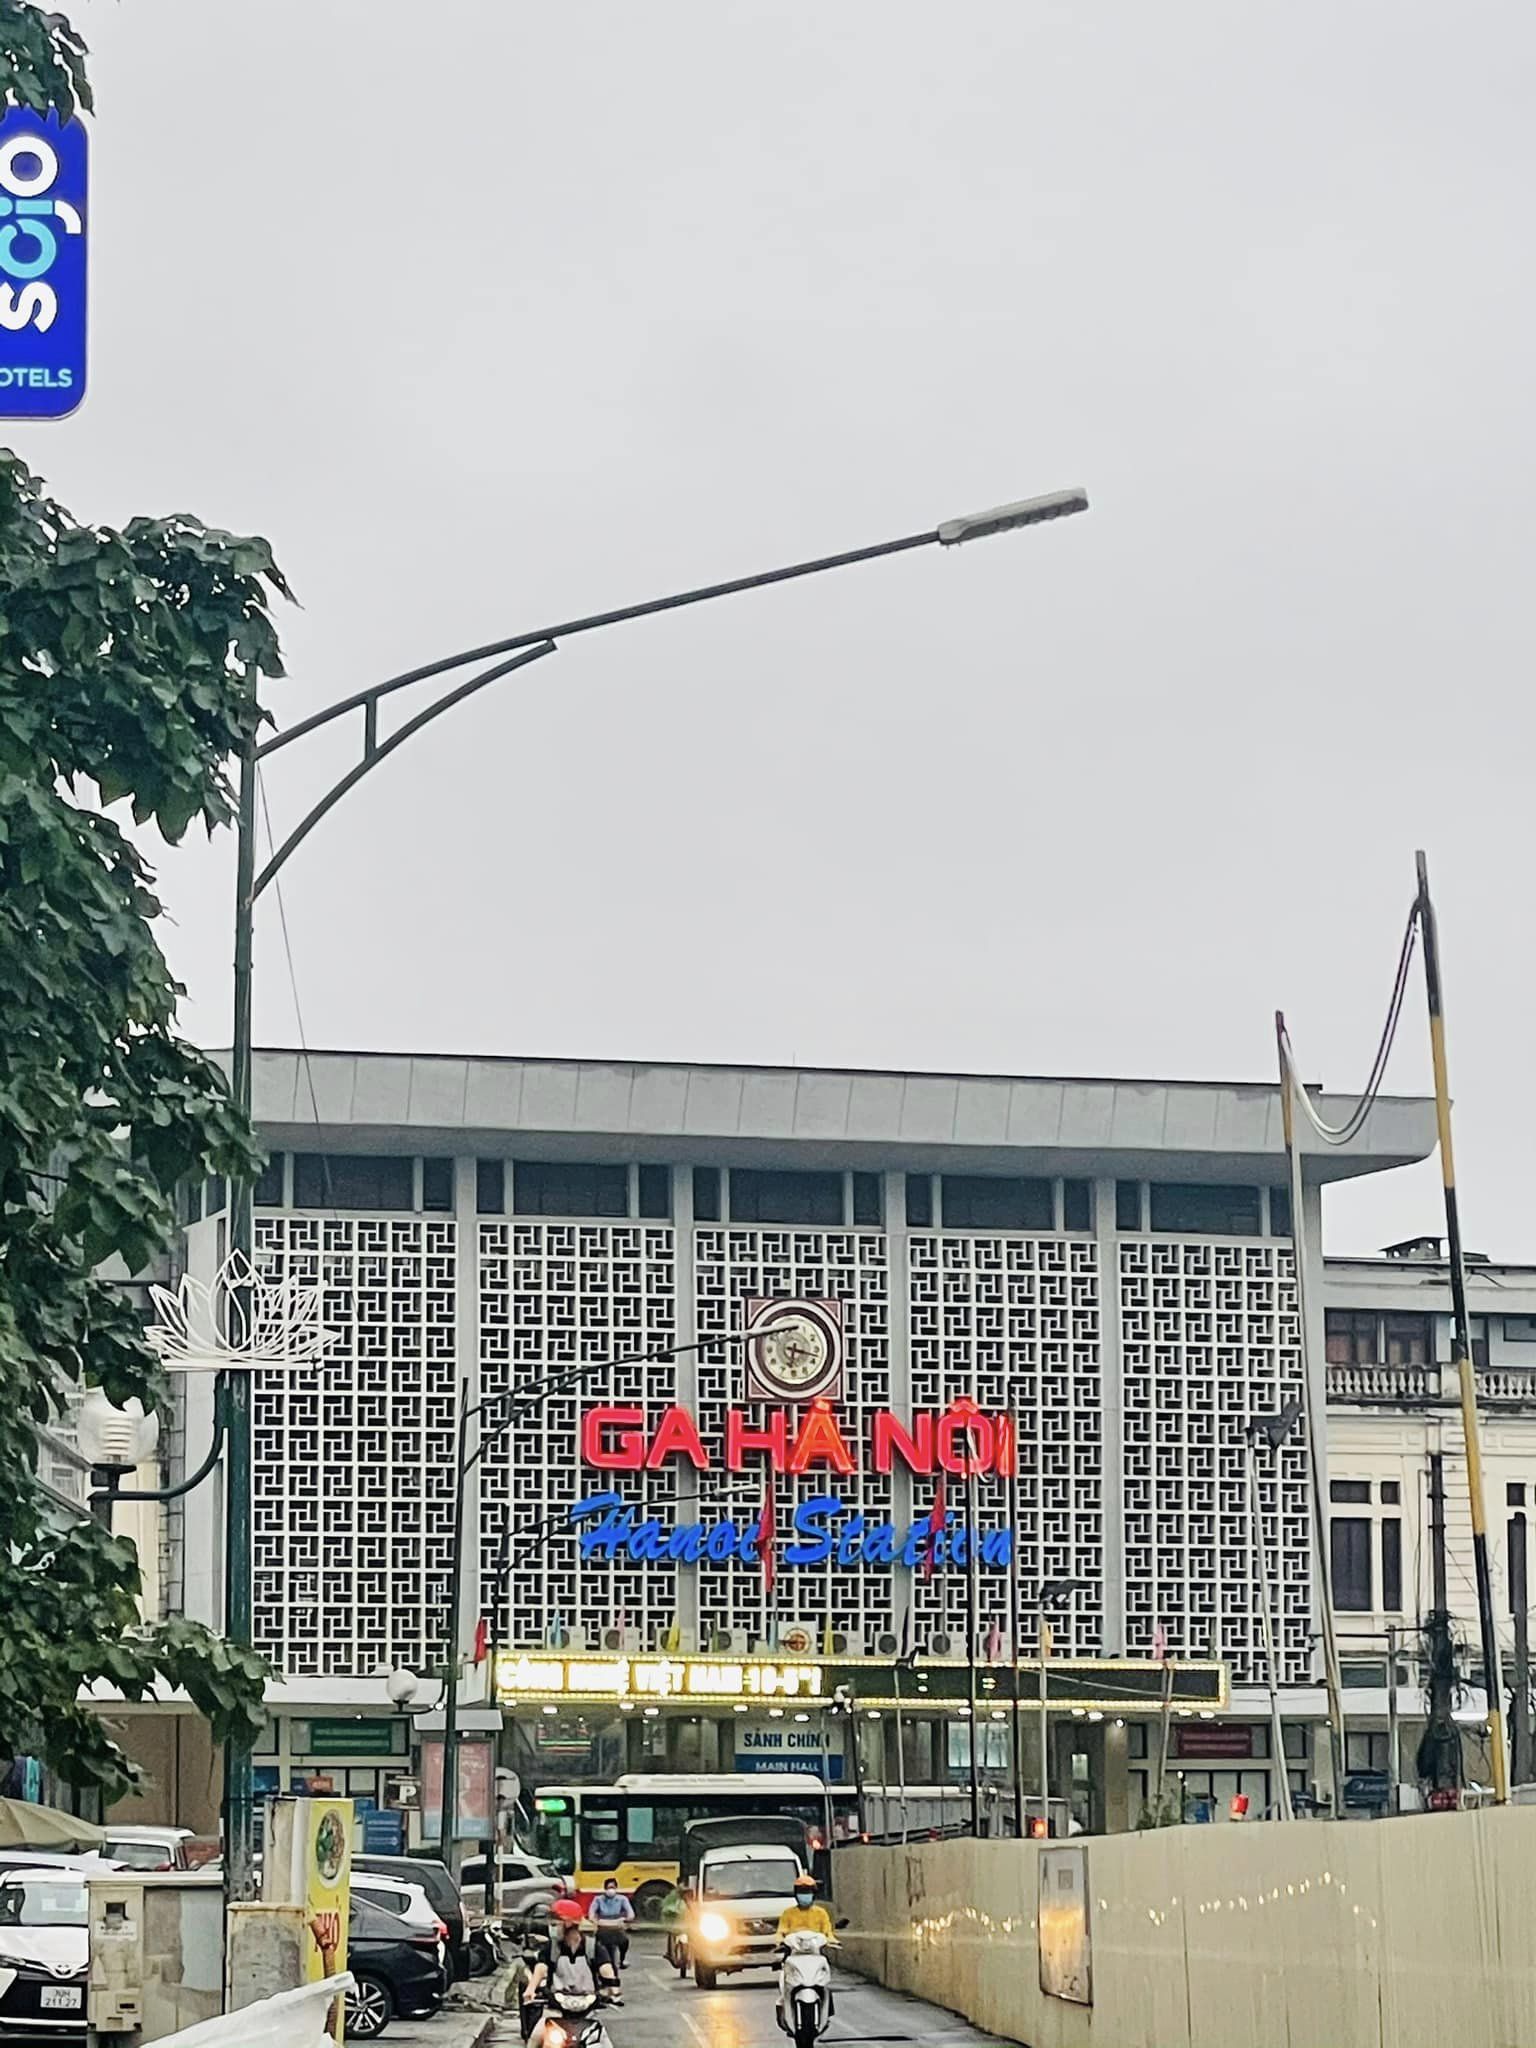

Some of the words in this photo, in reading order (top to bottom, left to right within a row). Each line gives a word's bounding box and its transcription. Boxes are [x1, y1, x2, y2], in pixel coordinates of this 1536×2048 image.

[581, 1406, 710, 1471] GA
[725, 1398, 856, 1476] HÀ
[874, 1396, 1015, 1480] NỘI
[570, 1491, 763, 1564] Hanoi
[784, 1495, 1013, 1567] Station
[399, 1785, 417, 1803] P
